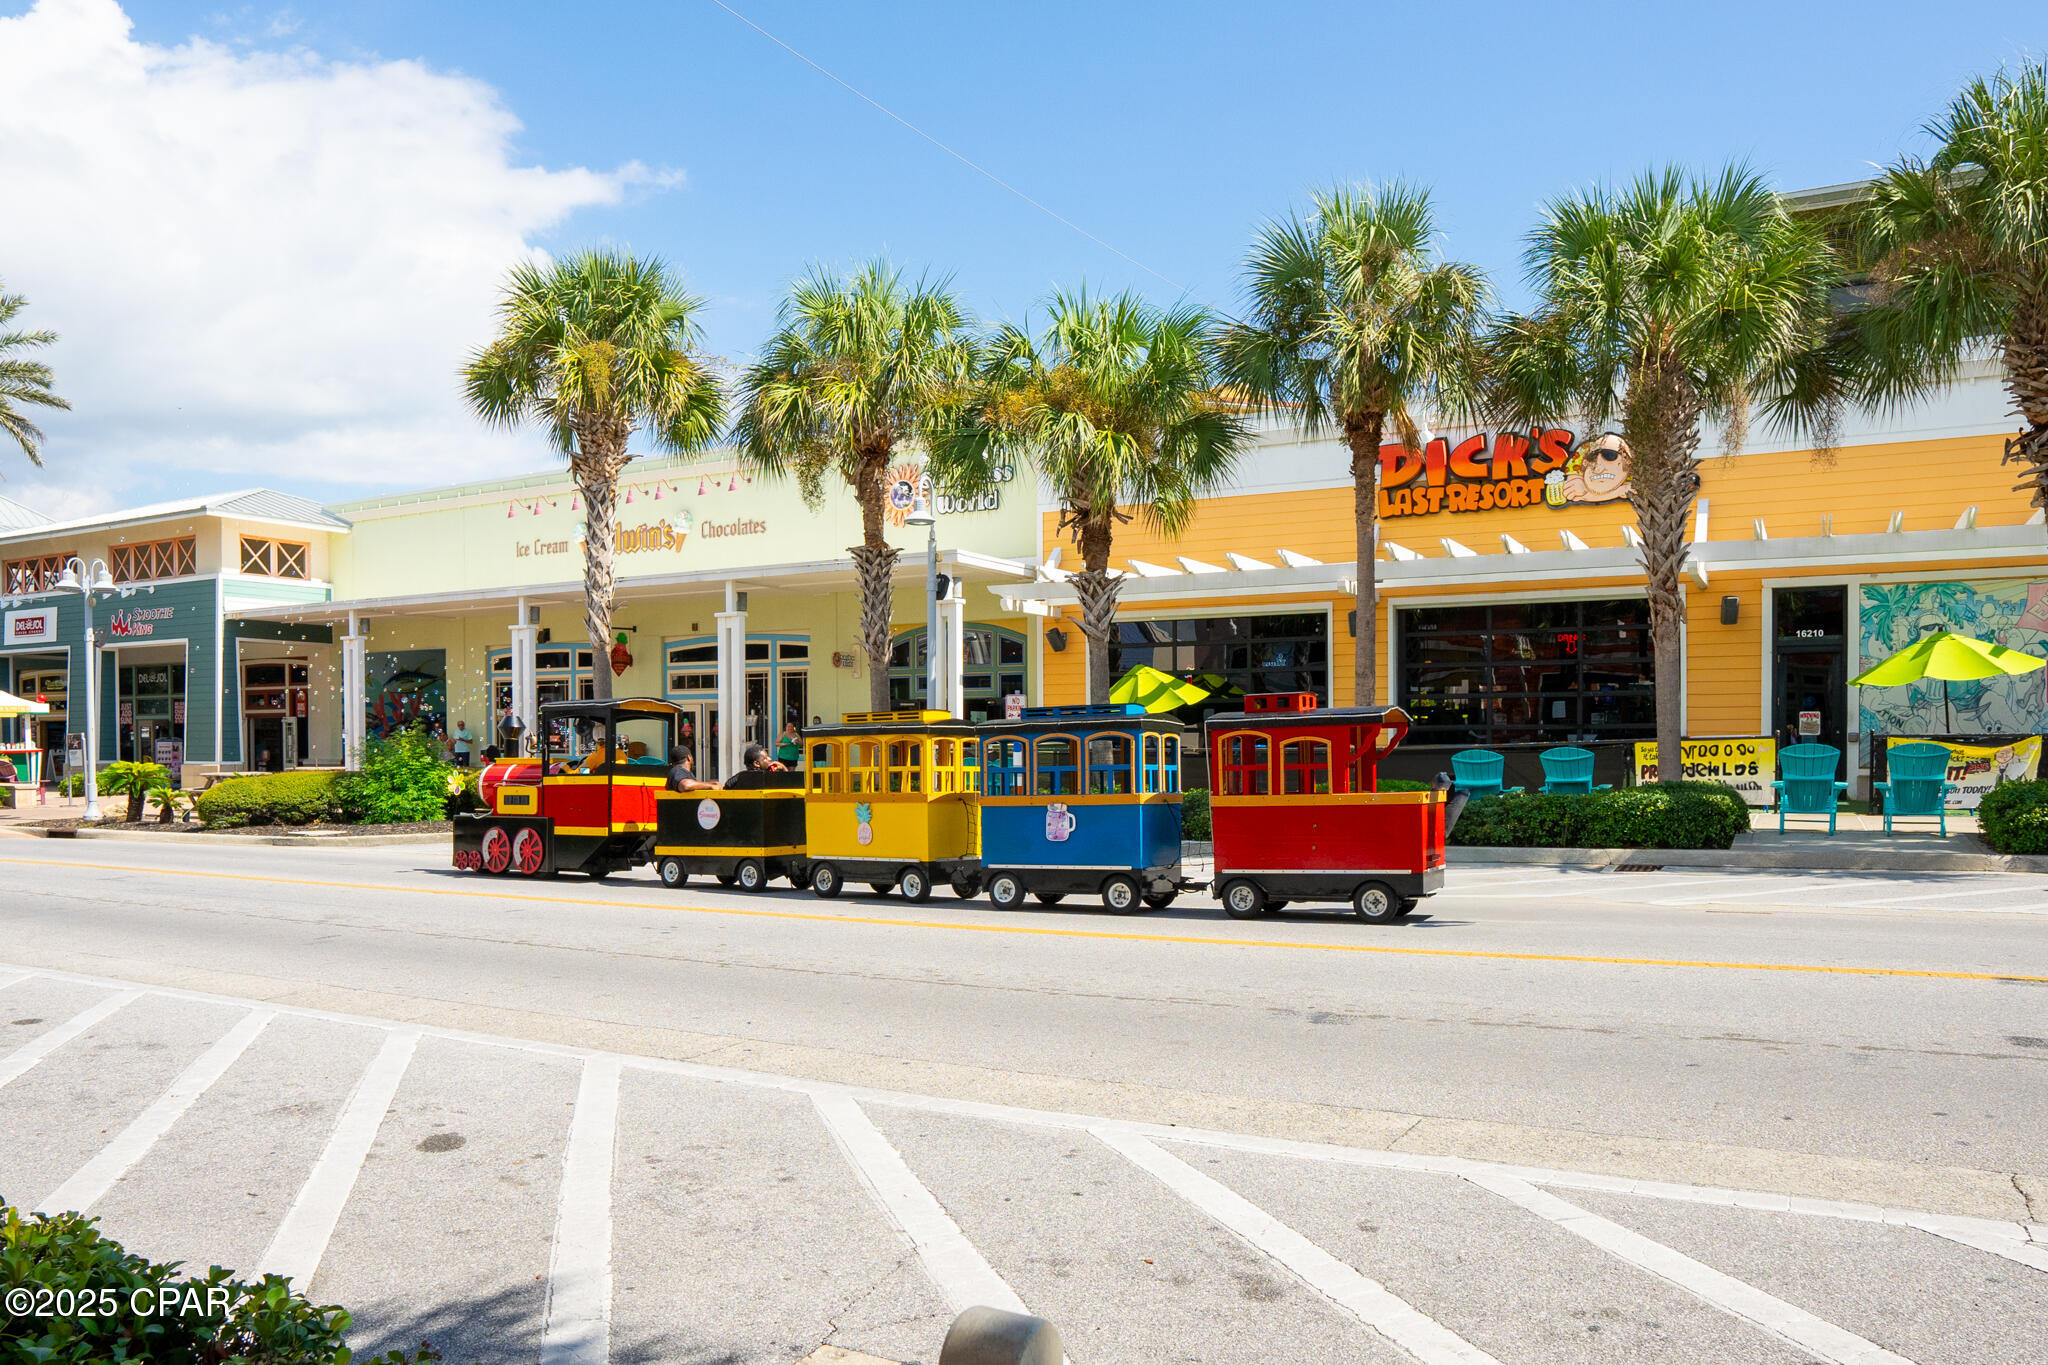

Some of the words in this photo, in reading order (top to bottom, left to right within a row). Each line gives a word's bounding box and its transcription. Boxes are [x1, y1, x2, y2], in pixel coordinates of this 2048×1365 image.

[1378, 427, 1575, 488] DICK'S
[1378, 485, 1444, 519] LAST
[1445, 477, 1545, 513] RESORT
[613, 519, 676, 555] lwin's
[701, 517, 767, 539] Chocolates
[516, 541, 530, 558] Ice
[534, 539, 568, 555] Cream
[1796, 629, 1824, 638] 16210
[1011, 697, 1020, 705] NO
[1877, 709, 1904, 729] TION
[1641, 764, 1658, 780] PR
[1963, 785, 1992, 794] TODAY!
